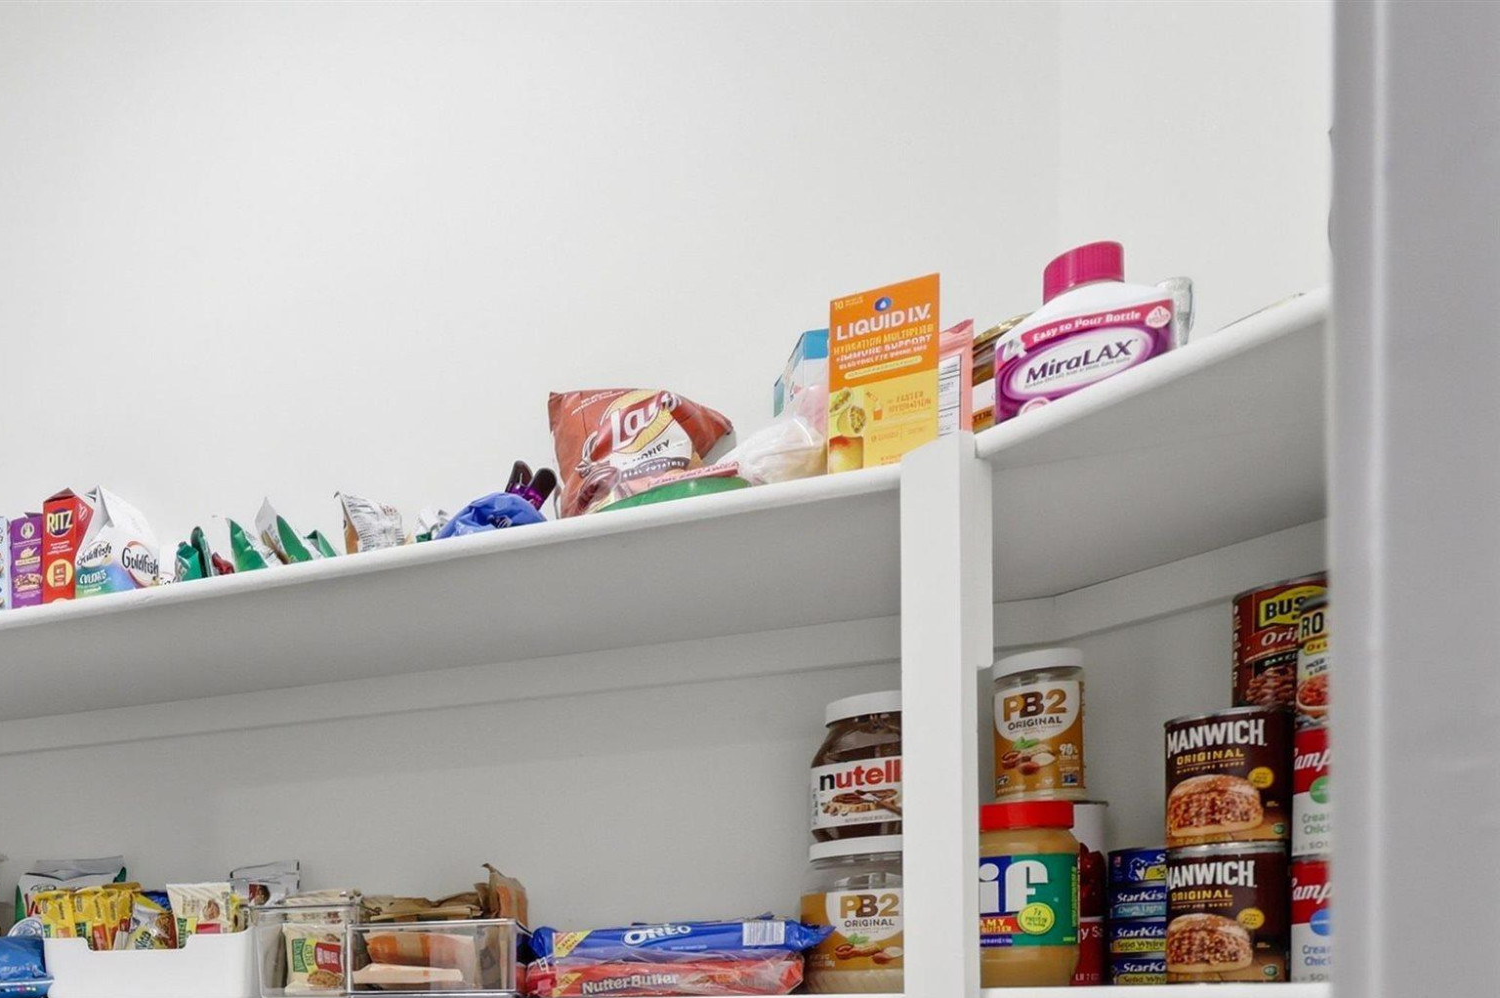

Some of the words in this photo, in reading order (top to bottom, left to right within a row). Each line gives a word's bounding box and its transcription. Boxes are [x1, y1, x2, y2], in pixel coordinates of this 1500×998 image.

[837, 311, 905, 341] LIQUID
[907, 303, 931, 323] I.V.
[1033, 328, 1057, 344] Easy
[1059, 323, 1072, 332] to
[1075, 317, 1102, 330] Pour
[1105, 310, 1142, 324] Bottle
[1026, 340, 1135, 385] MiraLAX
[47, 510, 73, 533] RITZ
[122, 547, 159, 578] Goldfish
[1003, 688, 1068, 723] PB2
[1007, 716, 1063, 731] ORIGINAL
[1167, 718, 1265, 759] MANWICH
[1177, 748, 1245, 766] ORIGINAL
[840, 893, 900, 919] PB2
[1171, 889, 1233, 902] ORIGINAL
[844, 918, 895, 928] ORIGINAL
